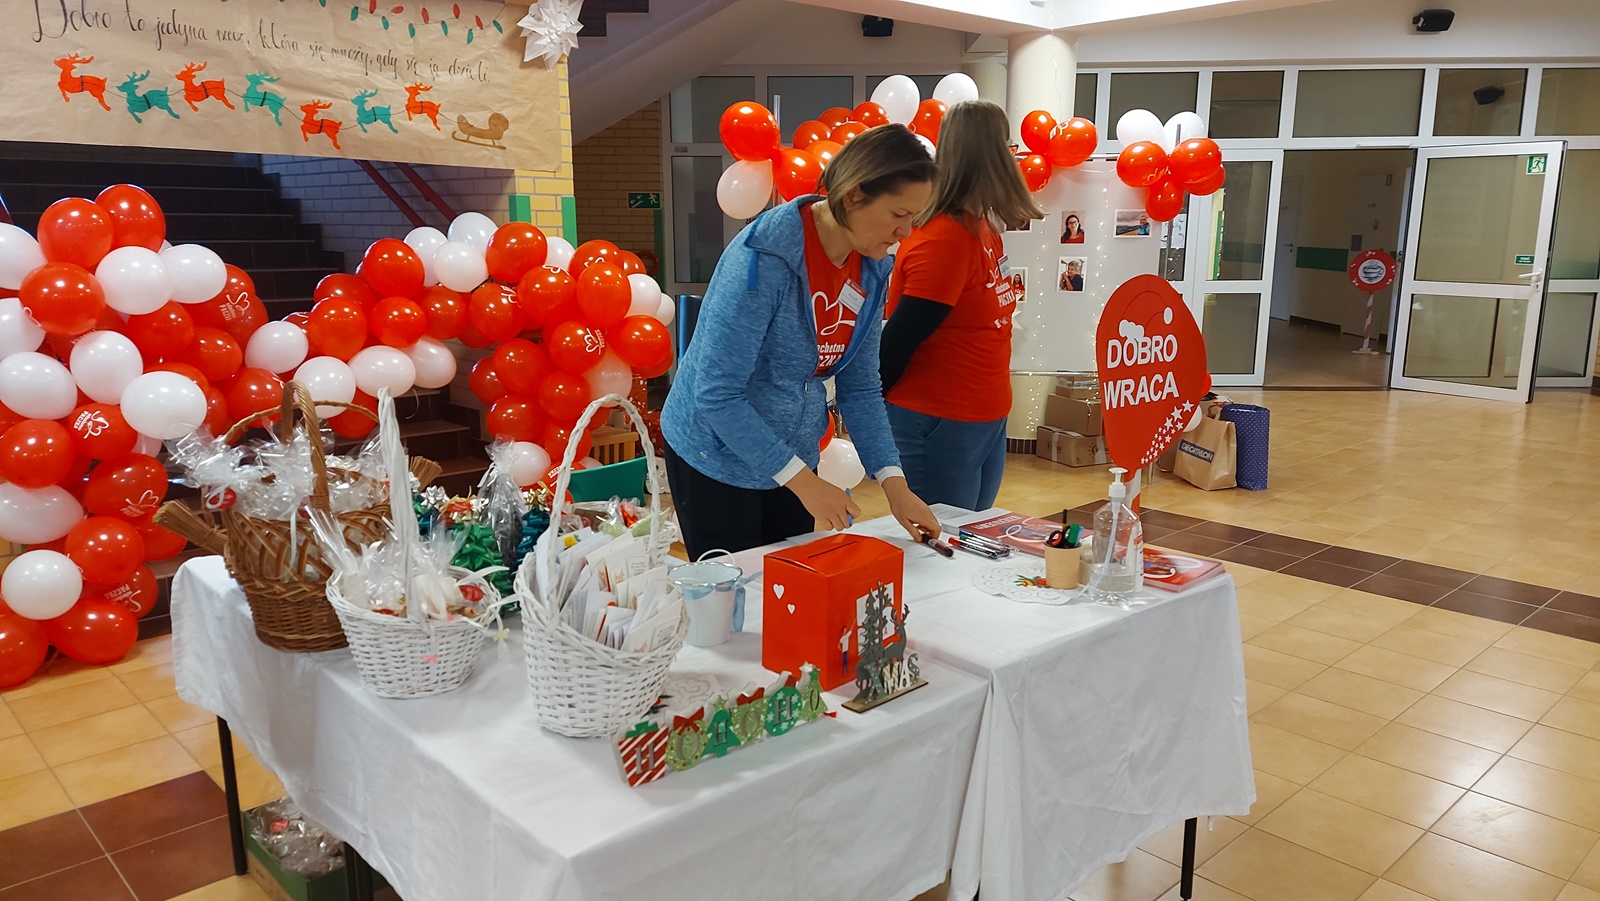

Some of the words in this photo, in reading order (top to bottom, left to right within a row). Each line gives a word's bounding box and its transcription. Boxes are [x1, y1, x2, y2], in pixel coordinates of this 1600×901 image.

[31, 0, 112, 43] Dobro
[124, 0, 145, 32] to
[155, 9, 208, 51] jedyna
[257, 18, 299, 51] która
[308, 40, 325, 62] się
[376, 49, 398, 79] gdy
[406, 57, 419, 76] się
[429, 58, 440, 81] ją
[1107, 334, 1178, 369] DOBRO
[1103, 371, 1180, 411] WRACA
[863, 653, 921, 706] XMAS
